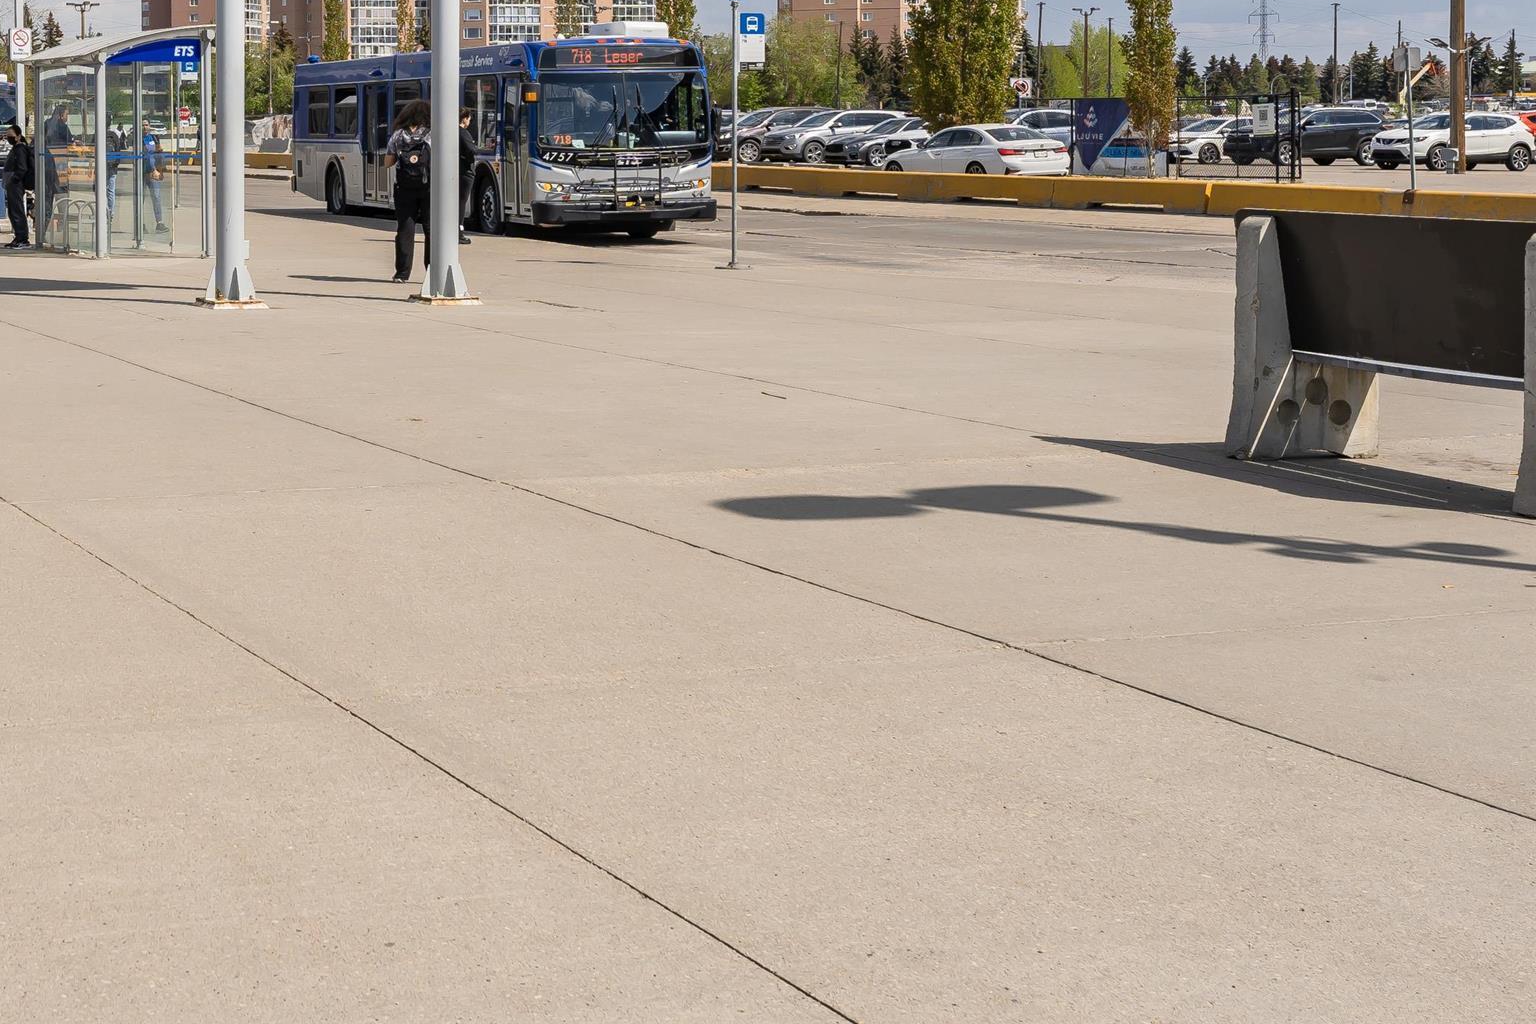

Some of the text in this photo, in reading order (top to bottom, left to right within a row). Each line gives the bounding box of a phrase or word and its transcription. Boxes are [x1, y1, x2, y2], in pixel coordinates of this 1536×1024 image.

[173, 45, 195, 57] ETS
[571, 48, 644, 64] 718 Leger
[474, 54, 494, 67] Service
[553, 135, 573, 145] 718
[542, 151, 574, 162] 4757
